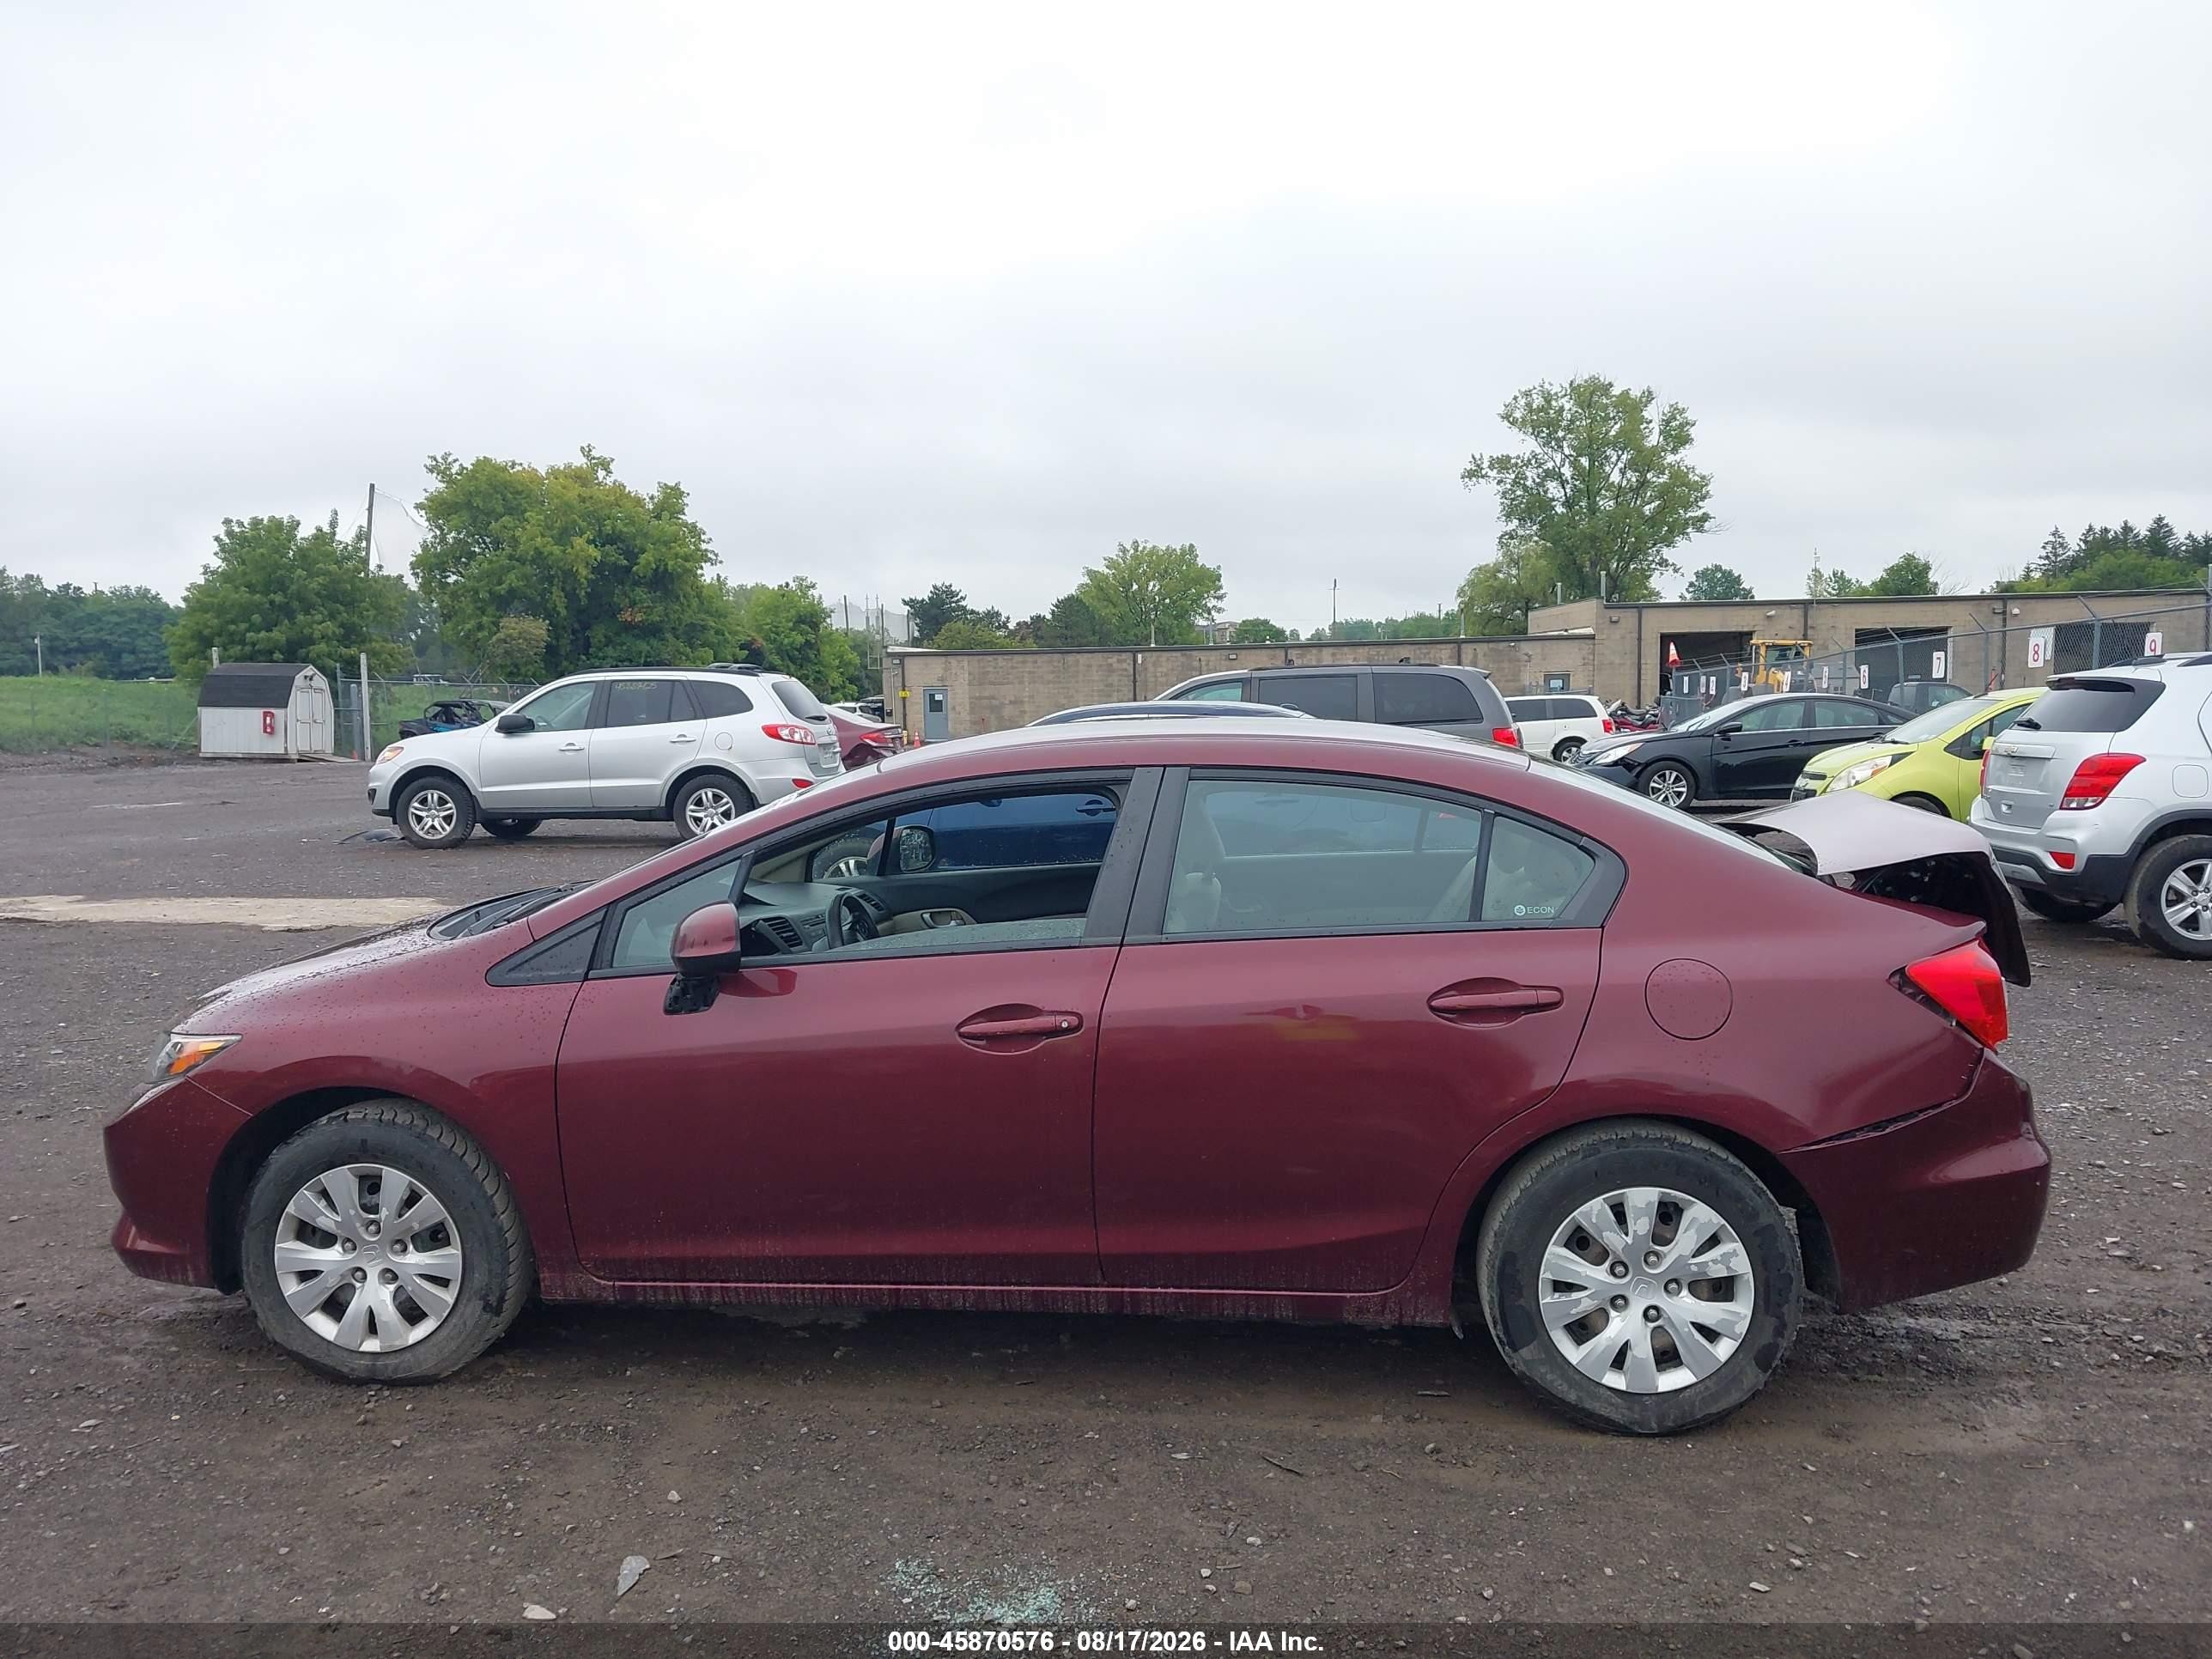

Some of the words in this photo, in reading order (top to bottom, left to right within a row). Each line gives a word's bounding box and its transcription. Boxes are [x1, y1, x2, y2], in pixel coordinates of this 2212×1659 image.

[2033, 643, 2040, 662] 8
[2149, 639, 2157, 655] 9
[1936, 657, 1942, 674] 7
